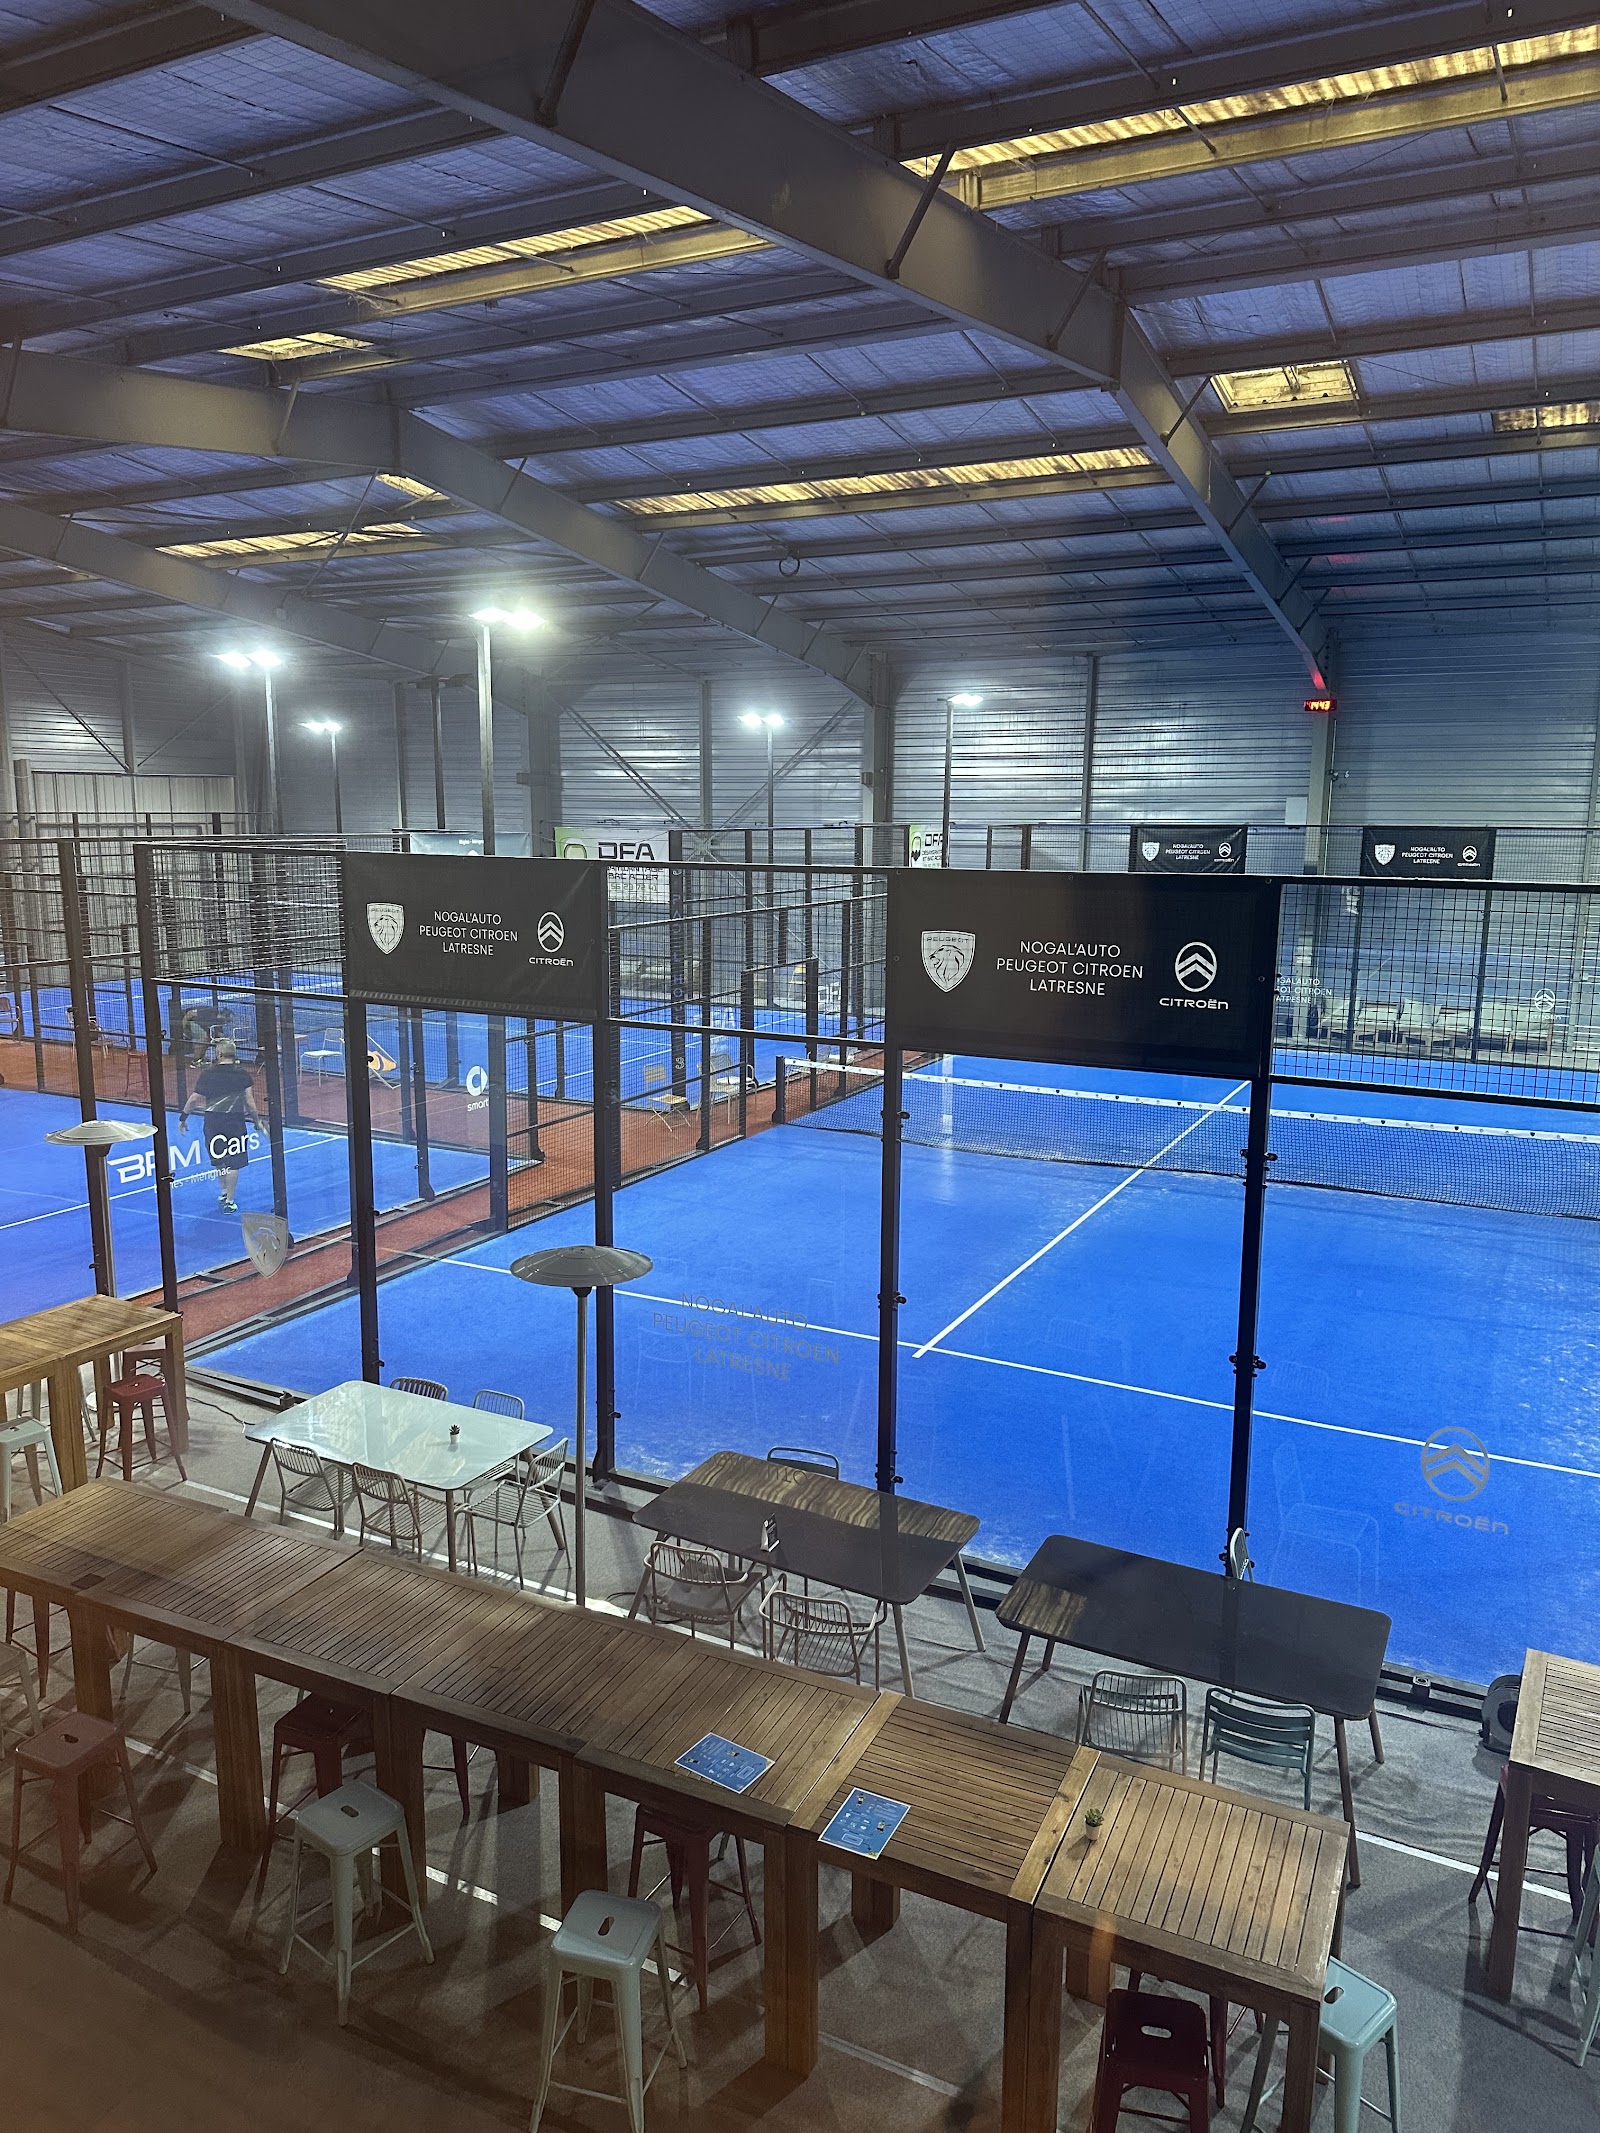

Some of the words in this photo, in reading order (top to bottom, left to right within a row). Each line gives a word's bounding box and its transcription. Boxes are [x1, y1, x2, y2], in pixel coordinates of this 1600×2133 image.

[598, 841, 655, 860] DFA
[434, 911, 502, 925] NOGAL'AUTO
[419, 925, 468, 939] PEUGEOT
[469, 928, 518, 942] CITROEN
[926, 936, 969, 944] PEUGEOT
[442, 942, 494, 956] LATRESNE
[1020, 941, 1121, 958] NOGAL'AUTO
[996, 958, 1068, 975] PEUGEOT
[1071, 962, 1144, 979] CITROEN
[1029, 978, 1106, 996] LATRESNE
[1275, 995, 1312, 1004] ATRESNE
[467, 1098, 489, 1112] smart
[209, 1132, 260, 1160] Cars
[653, 1312, 741, 1344] PEUGEOT
[749, 1331, 839, 1365] CITROEN
[696, 1346, 791, 1381] LATRESNE
